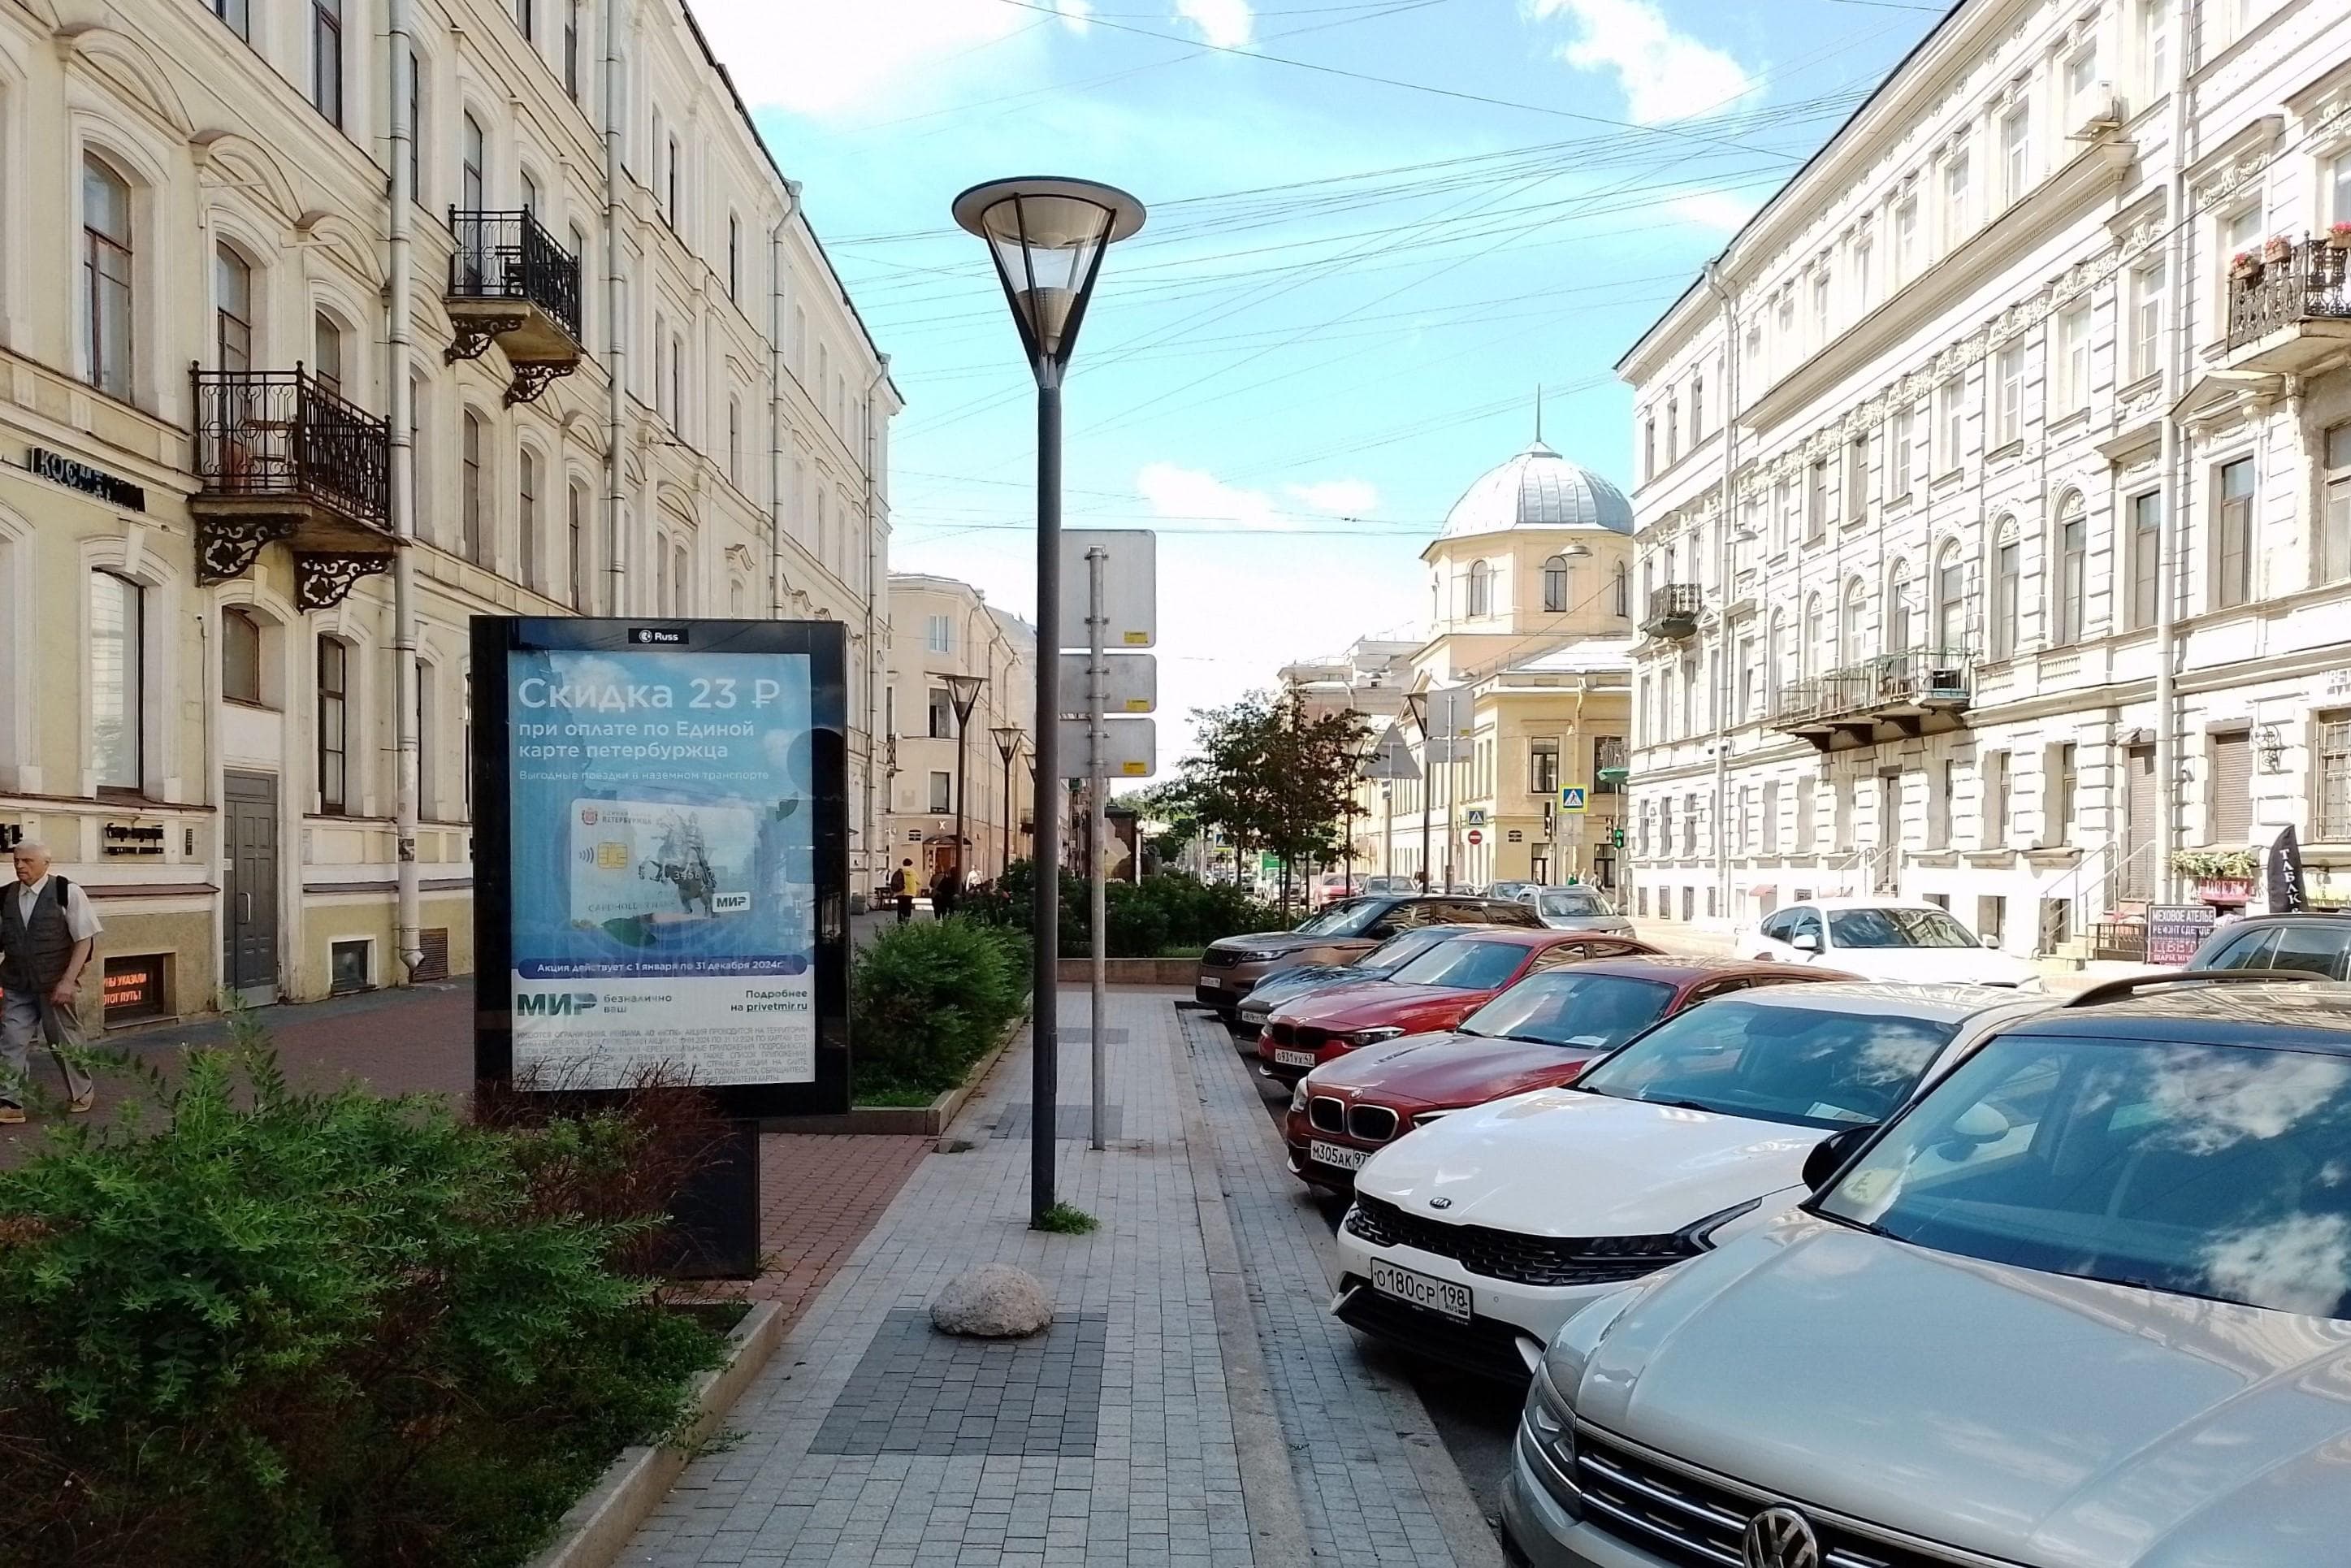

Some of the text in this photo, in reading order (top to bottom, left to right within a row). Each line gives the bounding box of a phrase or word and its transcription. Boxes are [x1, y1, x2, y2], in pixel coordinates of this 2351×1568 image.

[654, 631, 679, 641] Russ
[518, 678, 673, 713] Скидка
[689, 678, 737, 708] 23
[519, 720, 755, 740] при оплате по Единой
[519, 743, 729, 760] карте петербуржца
[519, 770, 578, 781] Выгодные
[582, 771, 629, 781] поездки
[642, 772, 699, 780] наземном
[702, 772, 769, 782] транспорте
[2280, 848, 2301, 904] ТАБАК
[716, 896, 747, 907] МИР
[2152, 909, 2214, 922] МЕХОВОЕ АТЕЛЬЕ
[2154, 941, 2197, 954] ЦВЕТ
[537, 963, 569, 973] Акция
[572, 962, 624, 973] действует
[642, 962, 677, 972] января
[695, 961, 706, 970] 31
[708, 961, 750, 970] декабря
[117, 973, 147, 985] УКАЗАЛИ
[120, 990, 141, 1002] ПУТЬ!
[604, 994, 672, 1003] безналично
[746, 990, 807, 999] Подробнее
[517, 993, 597, 1016] МИР
[604, 1006, 626, 1014] ваш
[747, 1002, 807, 1012] privetmir.ru
[1312, 1145, 1352, 1167] М305АК
[1432, 1198, 1448, 1207] KIA
[1377, 1269, 1465, 1307] О180СР 198
[1445, 1303, 1458, 1314] RUS
